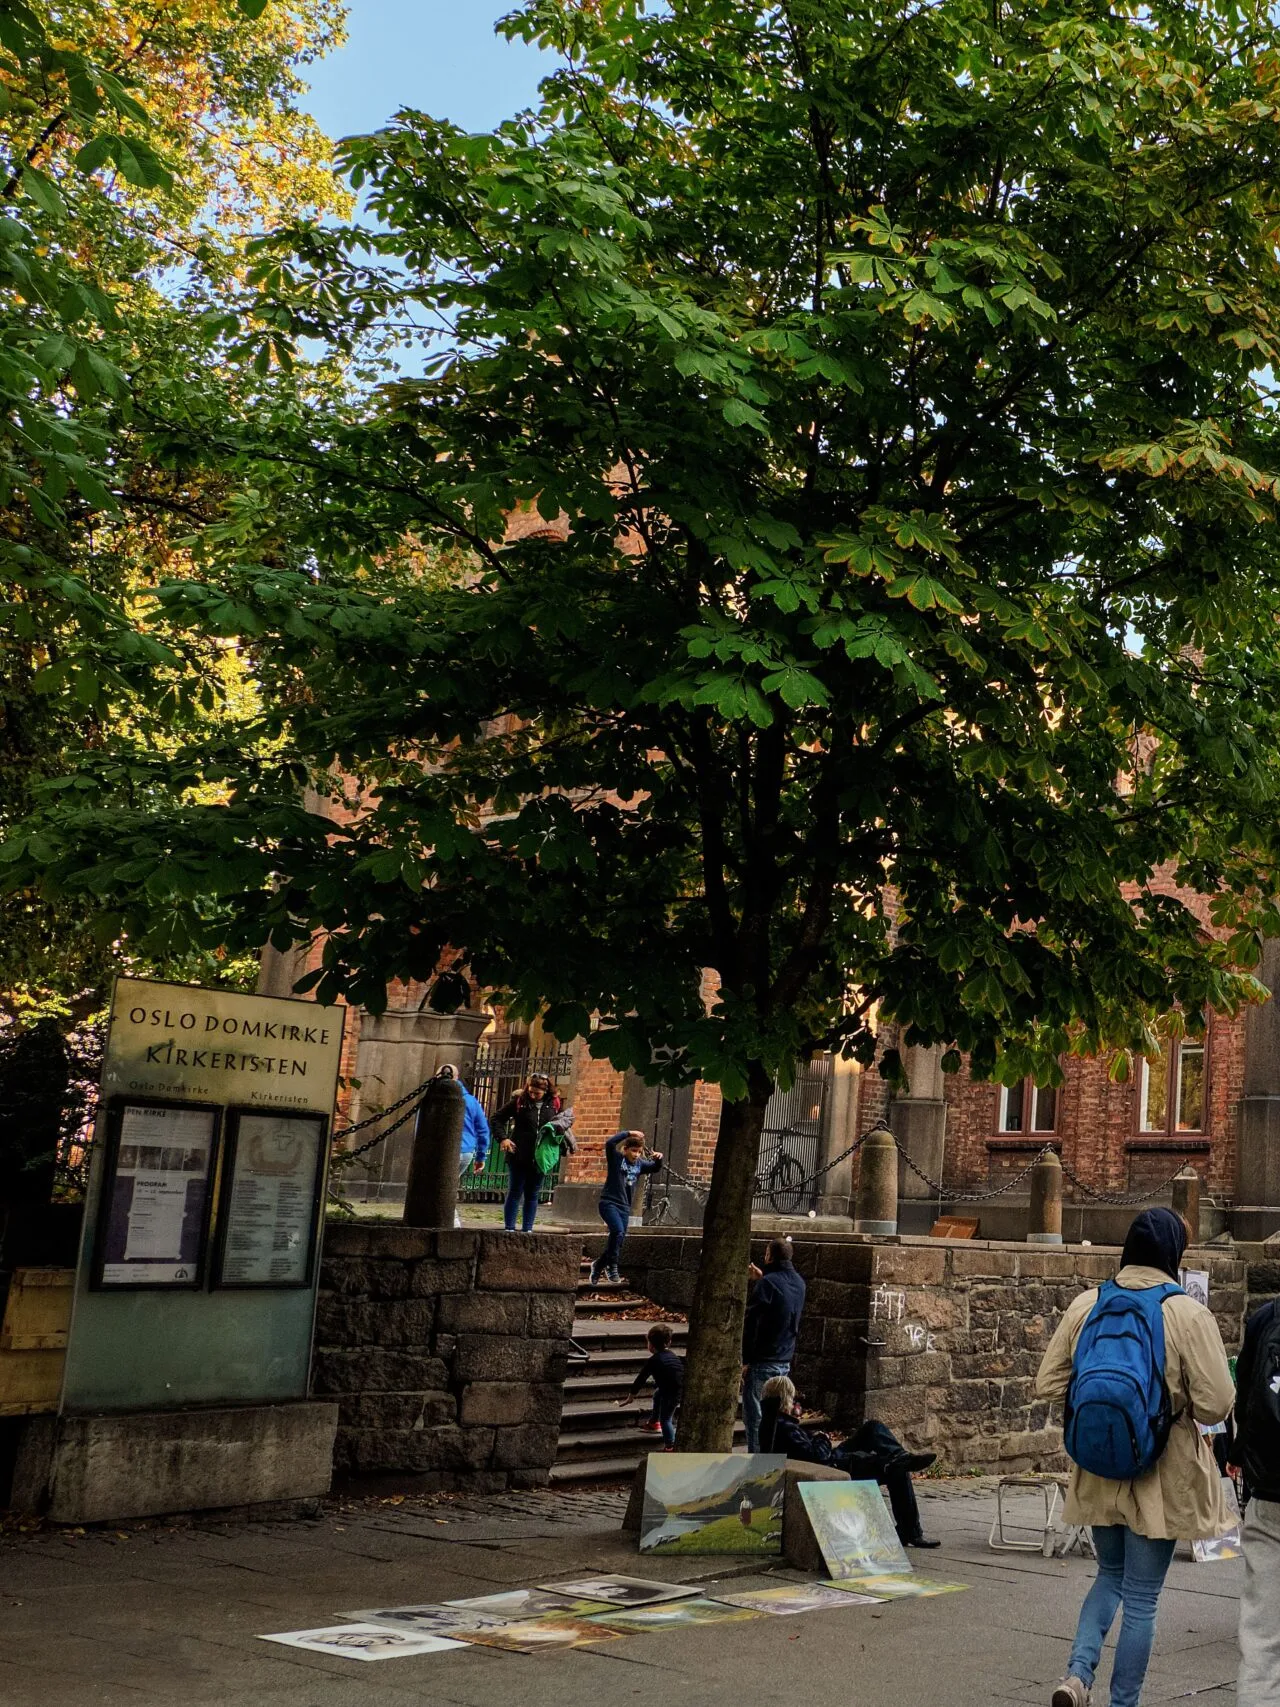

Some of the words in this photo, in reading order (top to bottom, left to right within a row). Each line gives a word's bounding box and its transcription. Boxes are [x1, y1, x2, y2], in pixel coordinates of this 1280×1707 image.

[129, 1007, 196, 1030] OSLO
[205, 1015, 330, 1045] DOMKIRKE
[146, 1046, 308, 1077] KIRKERISTEN
[129, 1080, 154, 1091] Oslo
[158, 1082, 209, 1095] Domkirke
[251, 1091, 308, 1104] Kirkeristen
